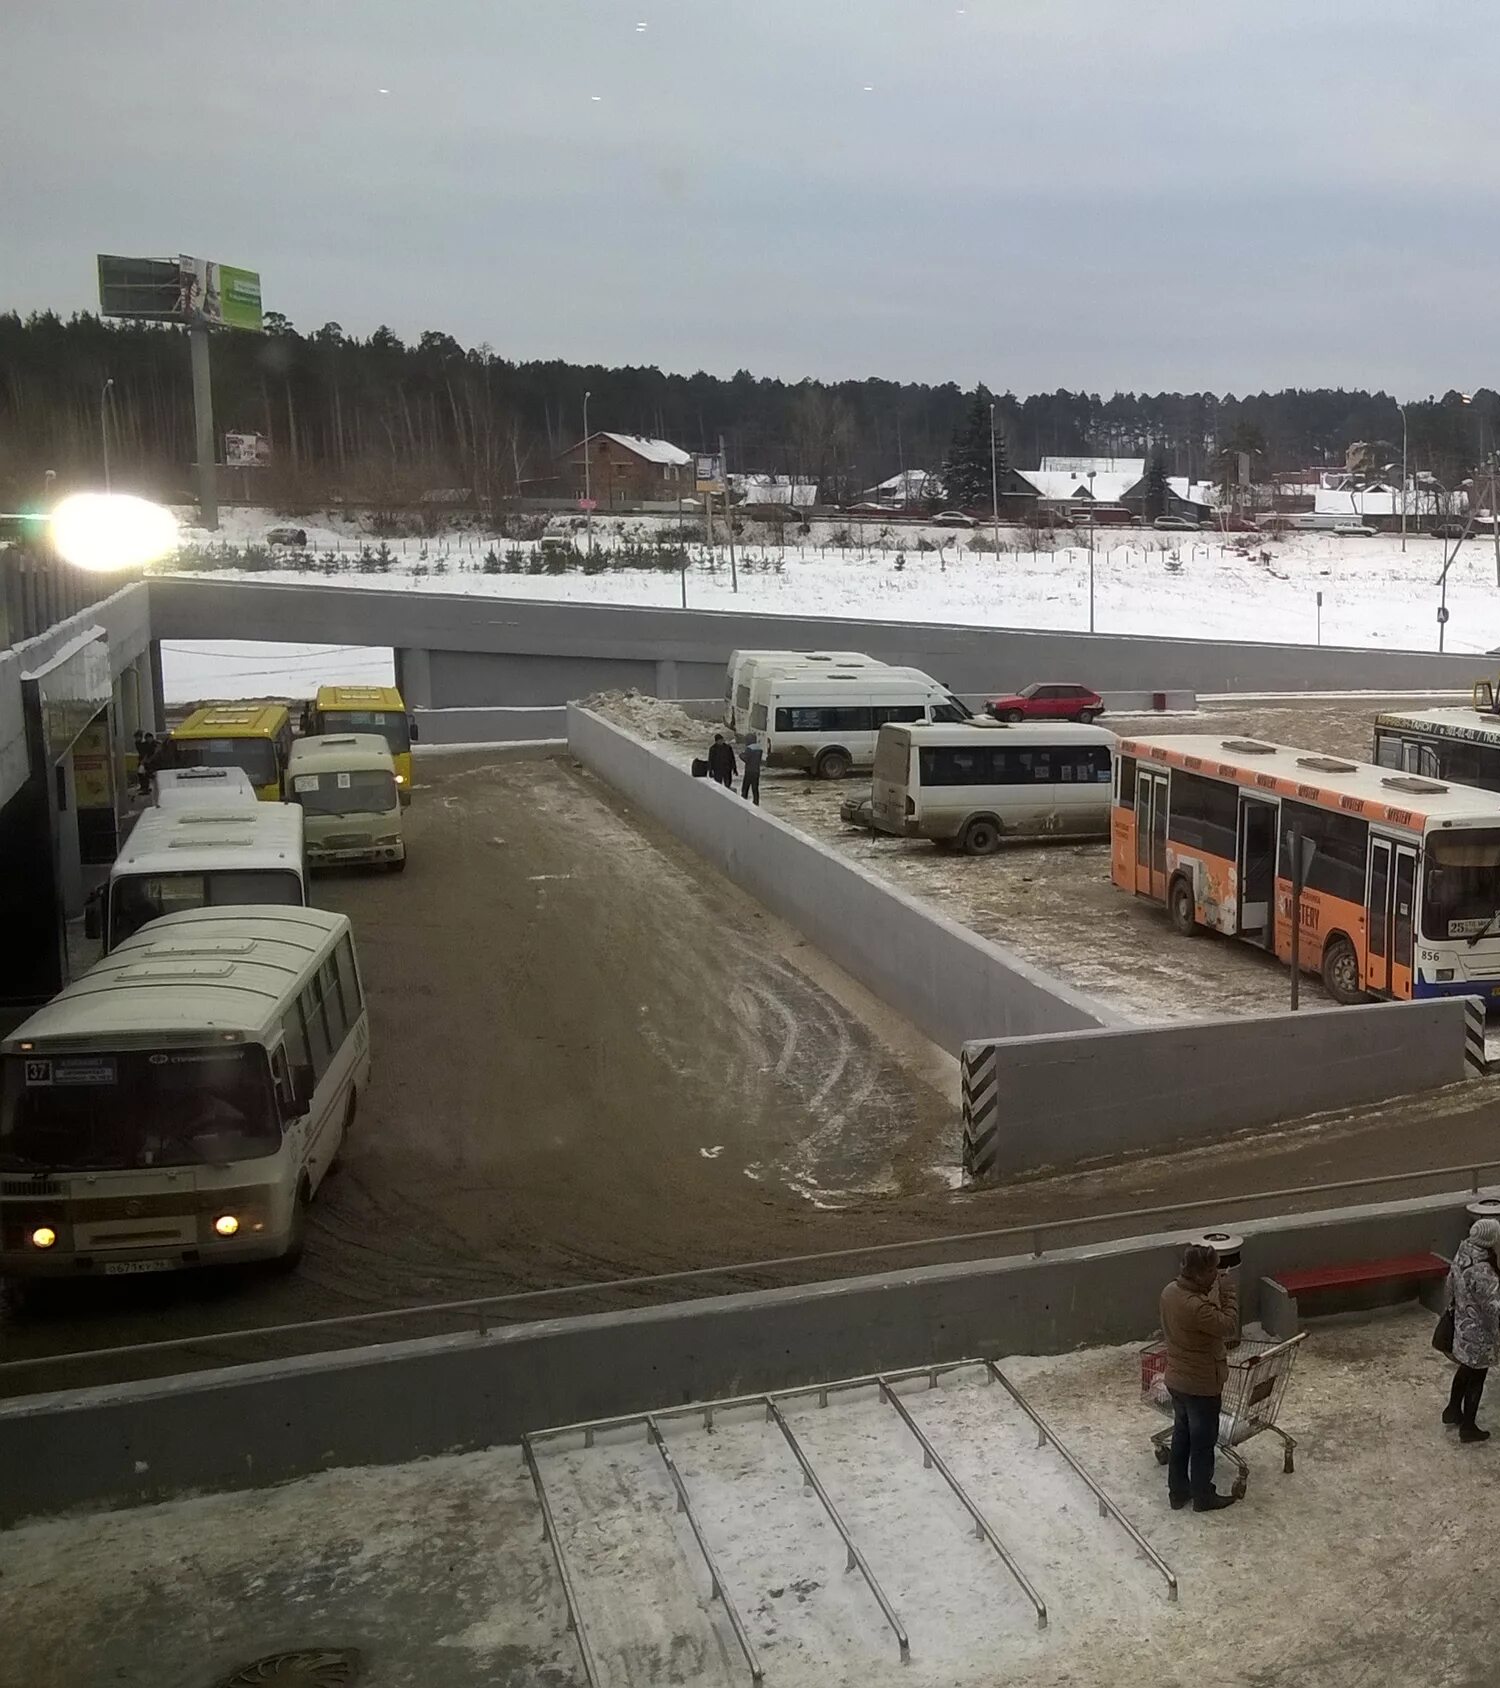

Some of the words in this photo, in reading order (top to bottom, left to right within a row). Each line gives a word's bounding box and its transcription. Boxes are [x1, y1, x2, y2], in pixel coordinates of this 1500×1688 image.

[1387, 807, 1413, 826] MYSTERY
[1451, 922, 1464, 933] 25
[1421, 950, 1440, 962] 856
[29, 1064, 46, 1080] 37
